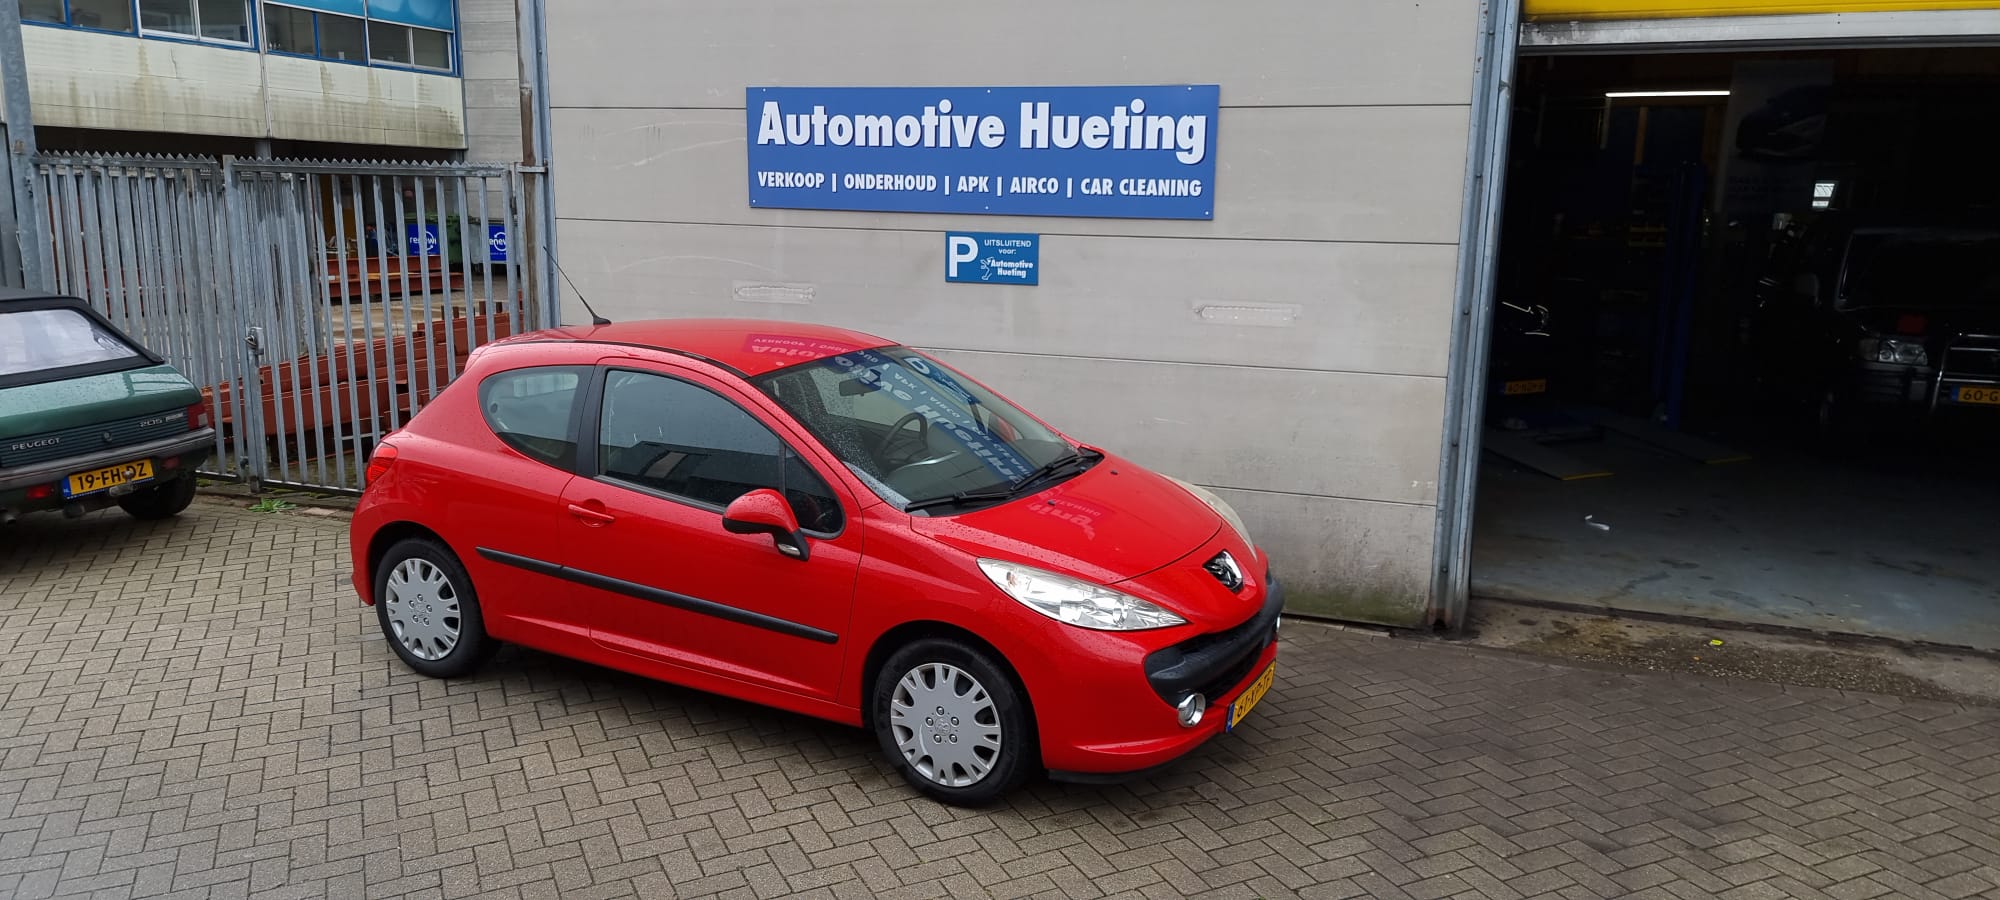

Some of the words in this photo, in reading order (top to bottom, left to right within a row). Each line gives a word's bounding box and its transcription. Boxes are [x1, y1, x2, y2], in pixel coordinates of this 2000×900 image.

[757, 99, 1006, 148] Automotive
[1020, 98, 1207, 164] Hueting
[757, 171, 825, 189] VERKOOP
[844, 173, 937, 192] ONDERHOUD
[957, 175, 989, 193] APK
[1010, 177, 1059, 194] AIRCO
[1081, 178, 1114, 195] CAR
[1119, 179, 1202, 197] CLEANING
[984, 239, 1032, 248] UITSLUITEND
[949, 235, 979, 278] P
[990, 259, 1034, 269] Automotive
[997, 268, 1027, 279] Hueting
[12, 437, 60, 451] PEUGEOT
